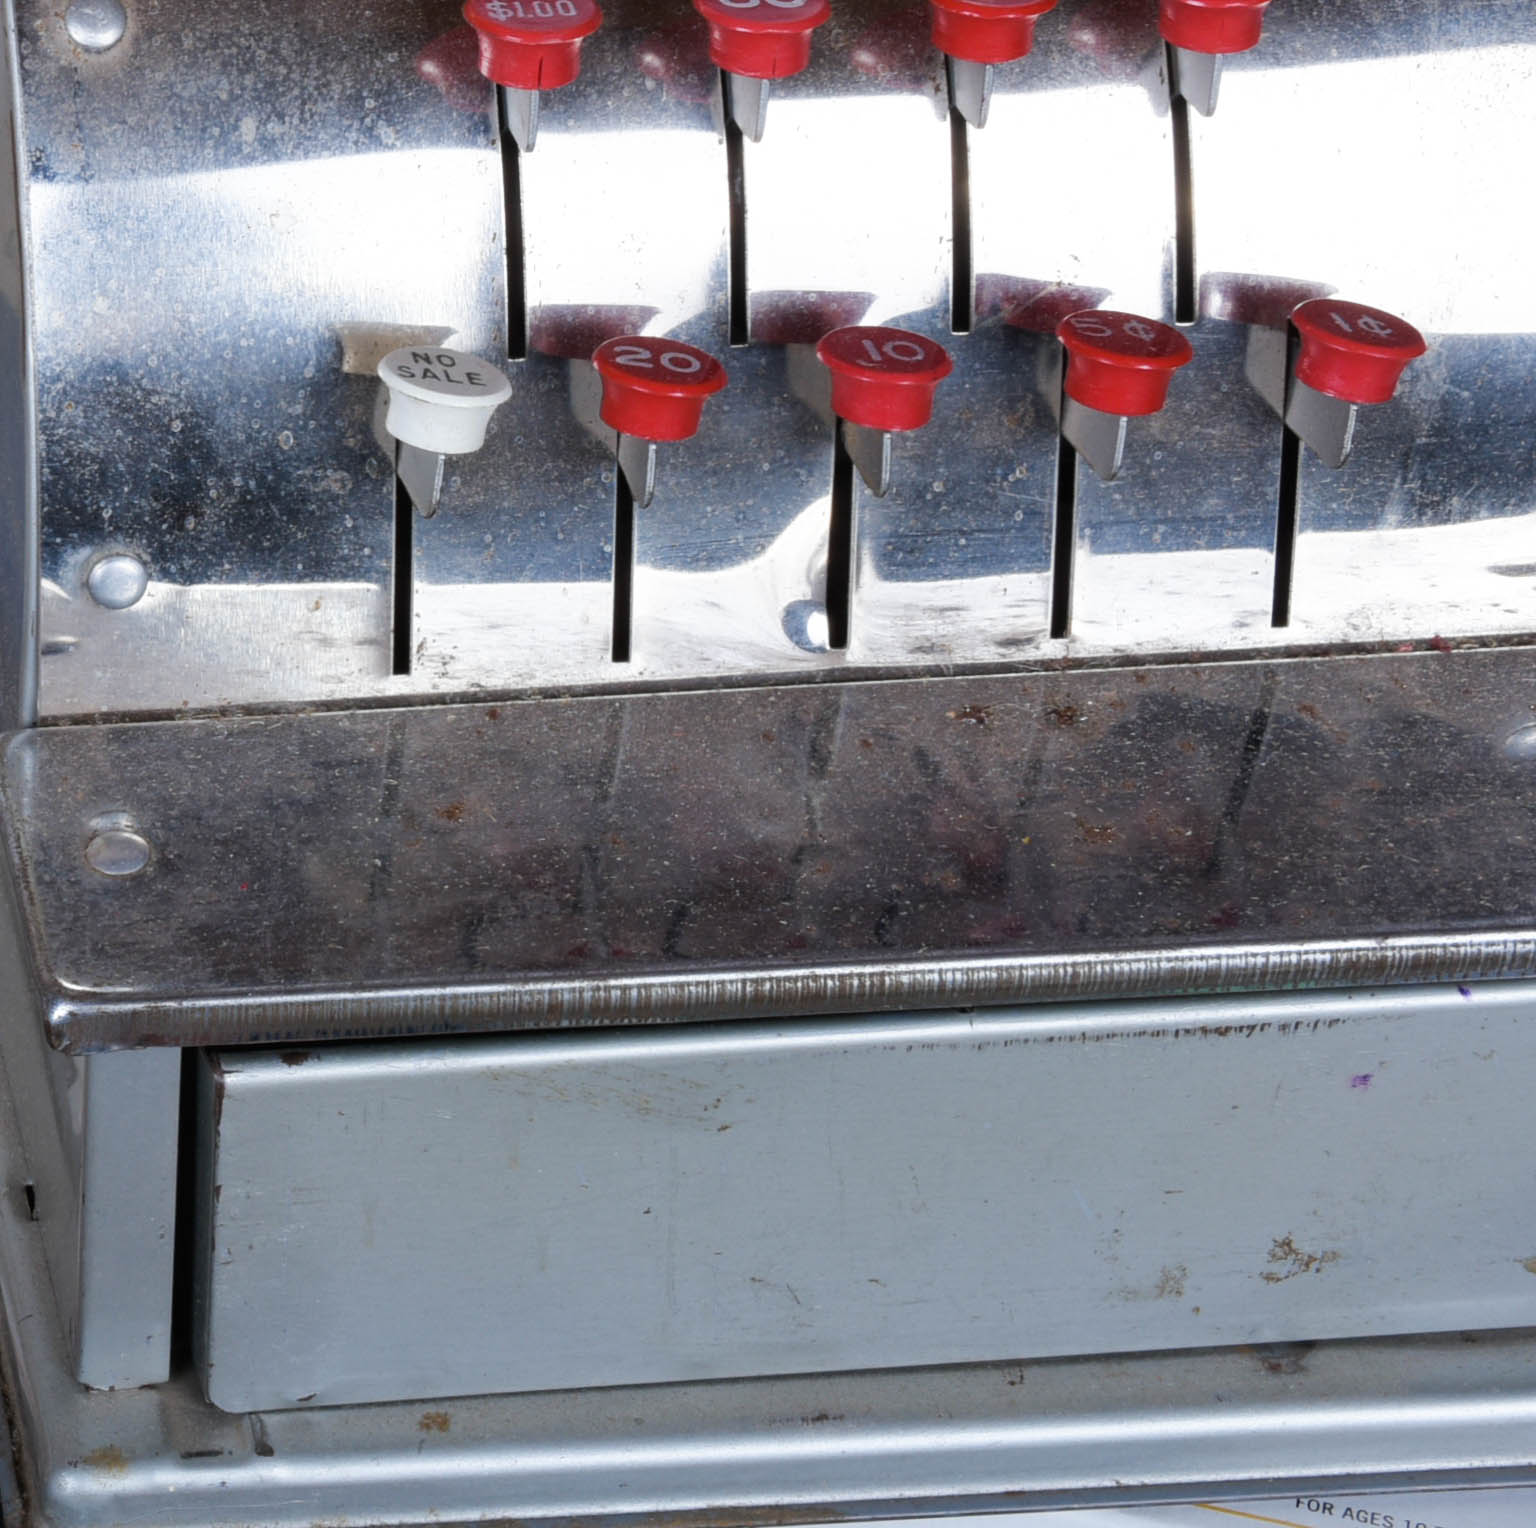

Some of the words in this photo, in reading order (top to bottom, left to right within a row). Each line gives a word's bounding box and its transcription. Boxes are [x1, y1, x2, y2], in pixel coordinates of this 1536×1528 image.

[410, 350, 457, 369] NO
[613, 345, 702, 373] 20
[860, 339, 926, 362] 10
[396, 364, 488, 387] SALE
[1295, 1496, 1335, 1516] FOR
[1341, 1506, 1395, 1528] AGES
